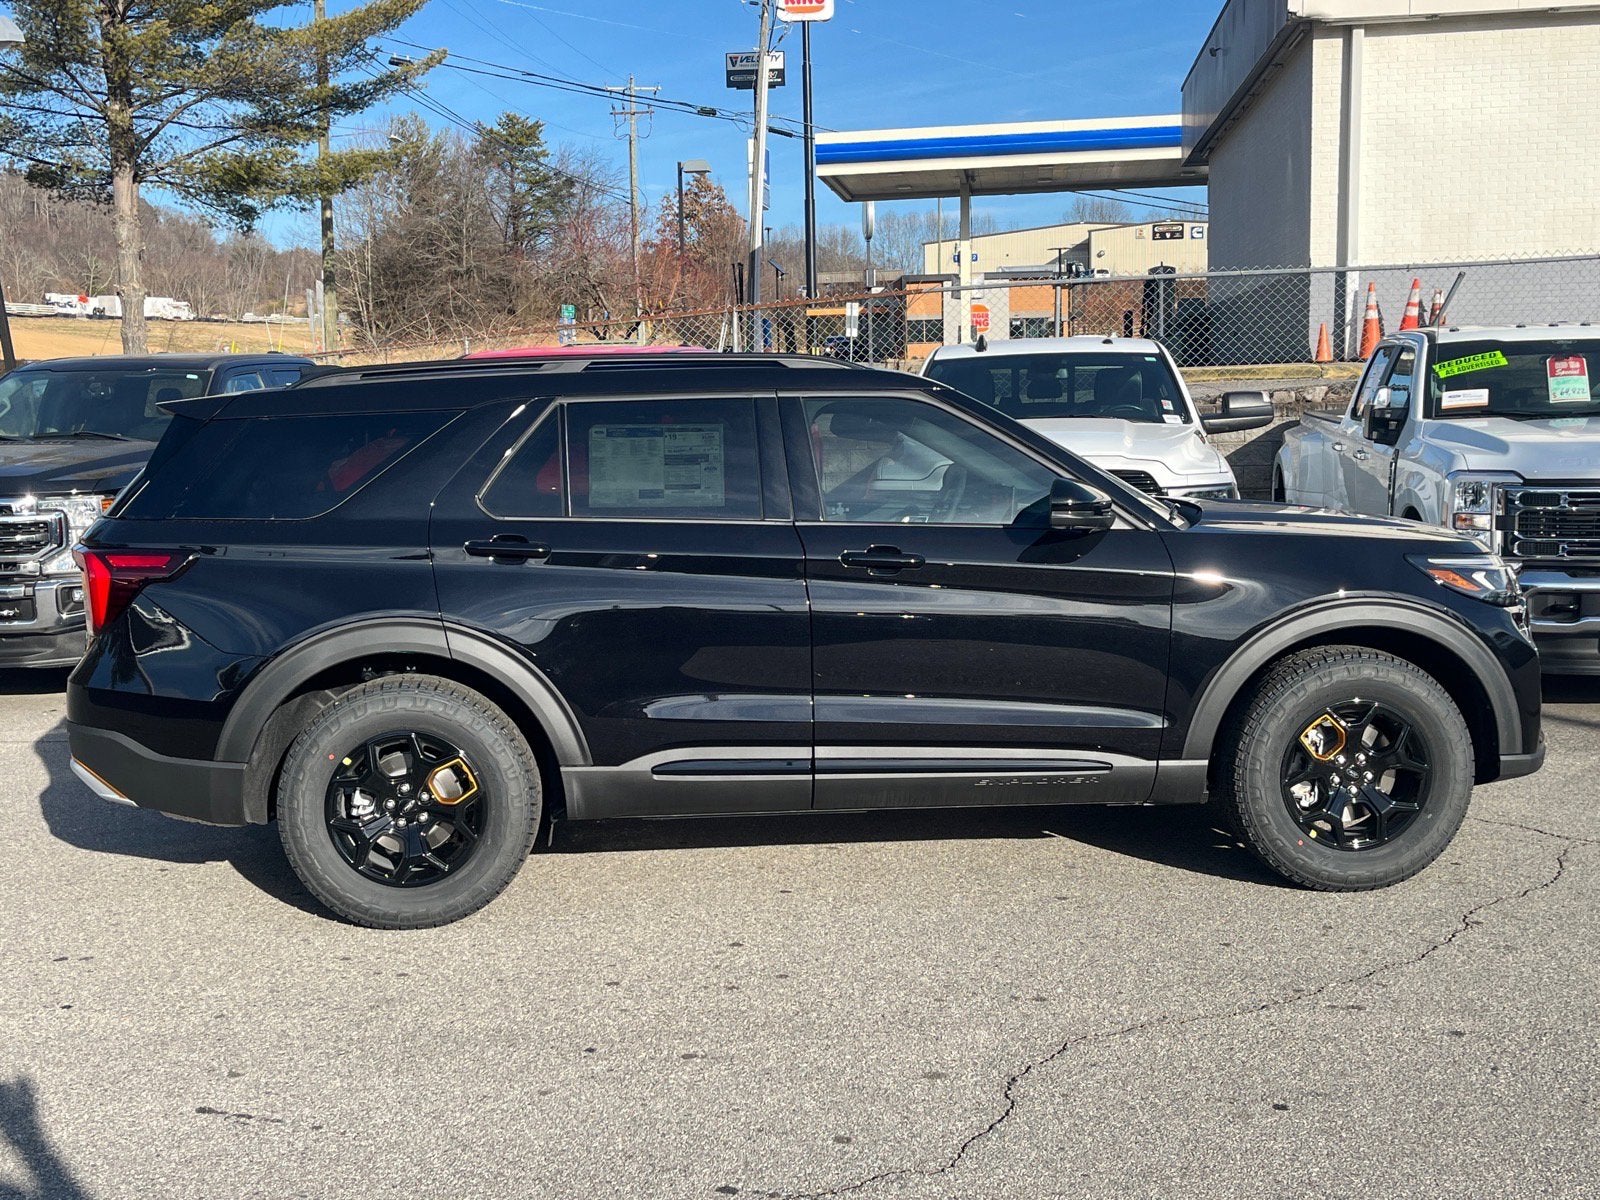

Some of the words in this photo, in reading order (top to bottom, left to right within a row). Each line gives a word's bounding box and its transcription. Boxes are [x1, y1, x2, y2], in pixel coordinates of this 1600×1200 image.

[1438, 352, 1497, 370] REDUCED
[1445, 368, 1455, 376] AS
[1457, 359, 1500, 373] ADVERTISED
